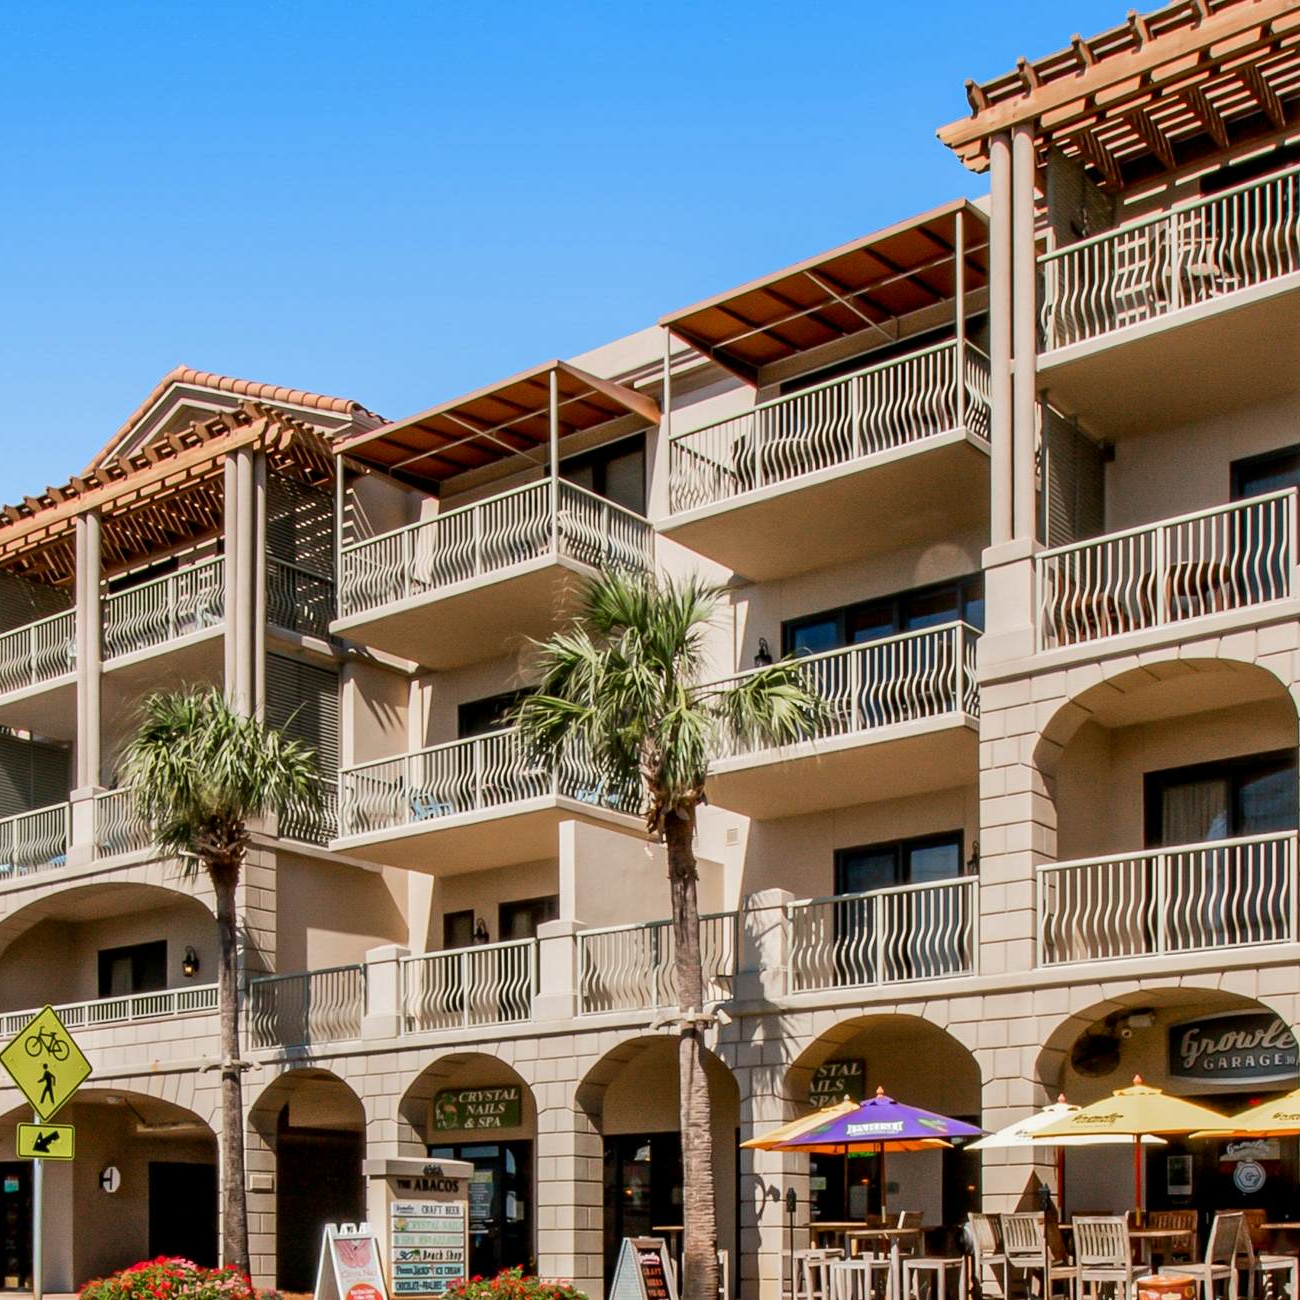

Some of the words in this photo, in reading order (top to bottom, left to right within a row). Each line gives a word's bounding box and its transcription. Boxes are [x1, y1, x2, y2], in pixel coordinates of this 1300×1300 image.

[1180, 1019, 1297, 1069] Growle
[1203, 1053, 1283, 1071] GARAGE
[818, 1063, 862, 1078] STAL
[459, 1088, 519, 1103] CRYSTAL
[466, 1103, 506, 1116] NAILS
[464, 1118, 475, 1129] &
[477, 1116, 501, 1128] SPA
[413, 1179, 459, 1193] ABACOS
[422, 1205, 443, 1215] CRAFT
[445, 1205, 460, 1215] BEER
[423, 1250, 443, 1261] Beach
[445, 1249, 463, 1262] Shop
